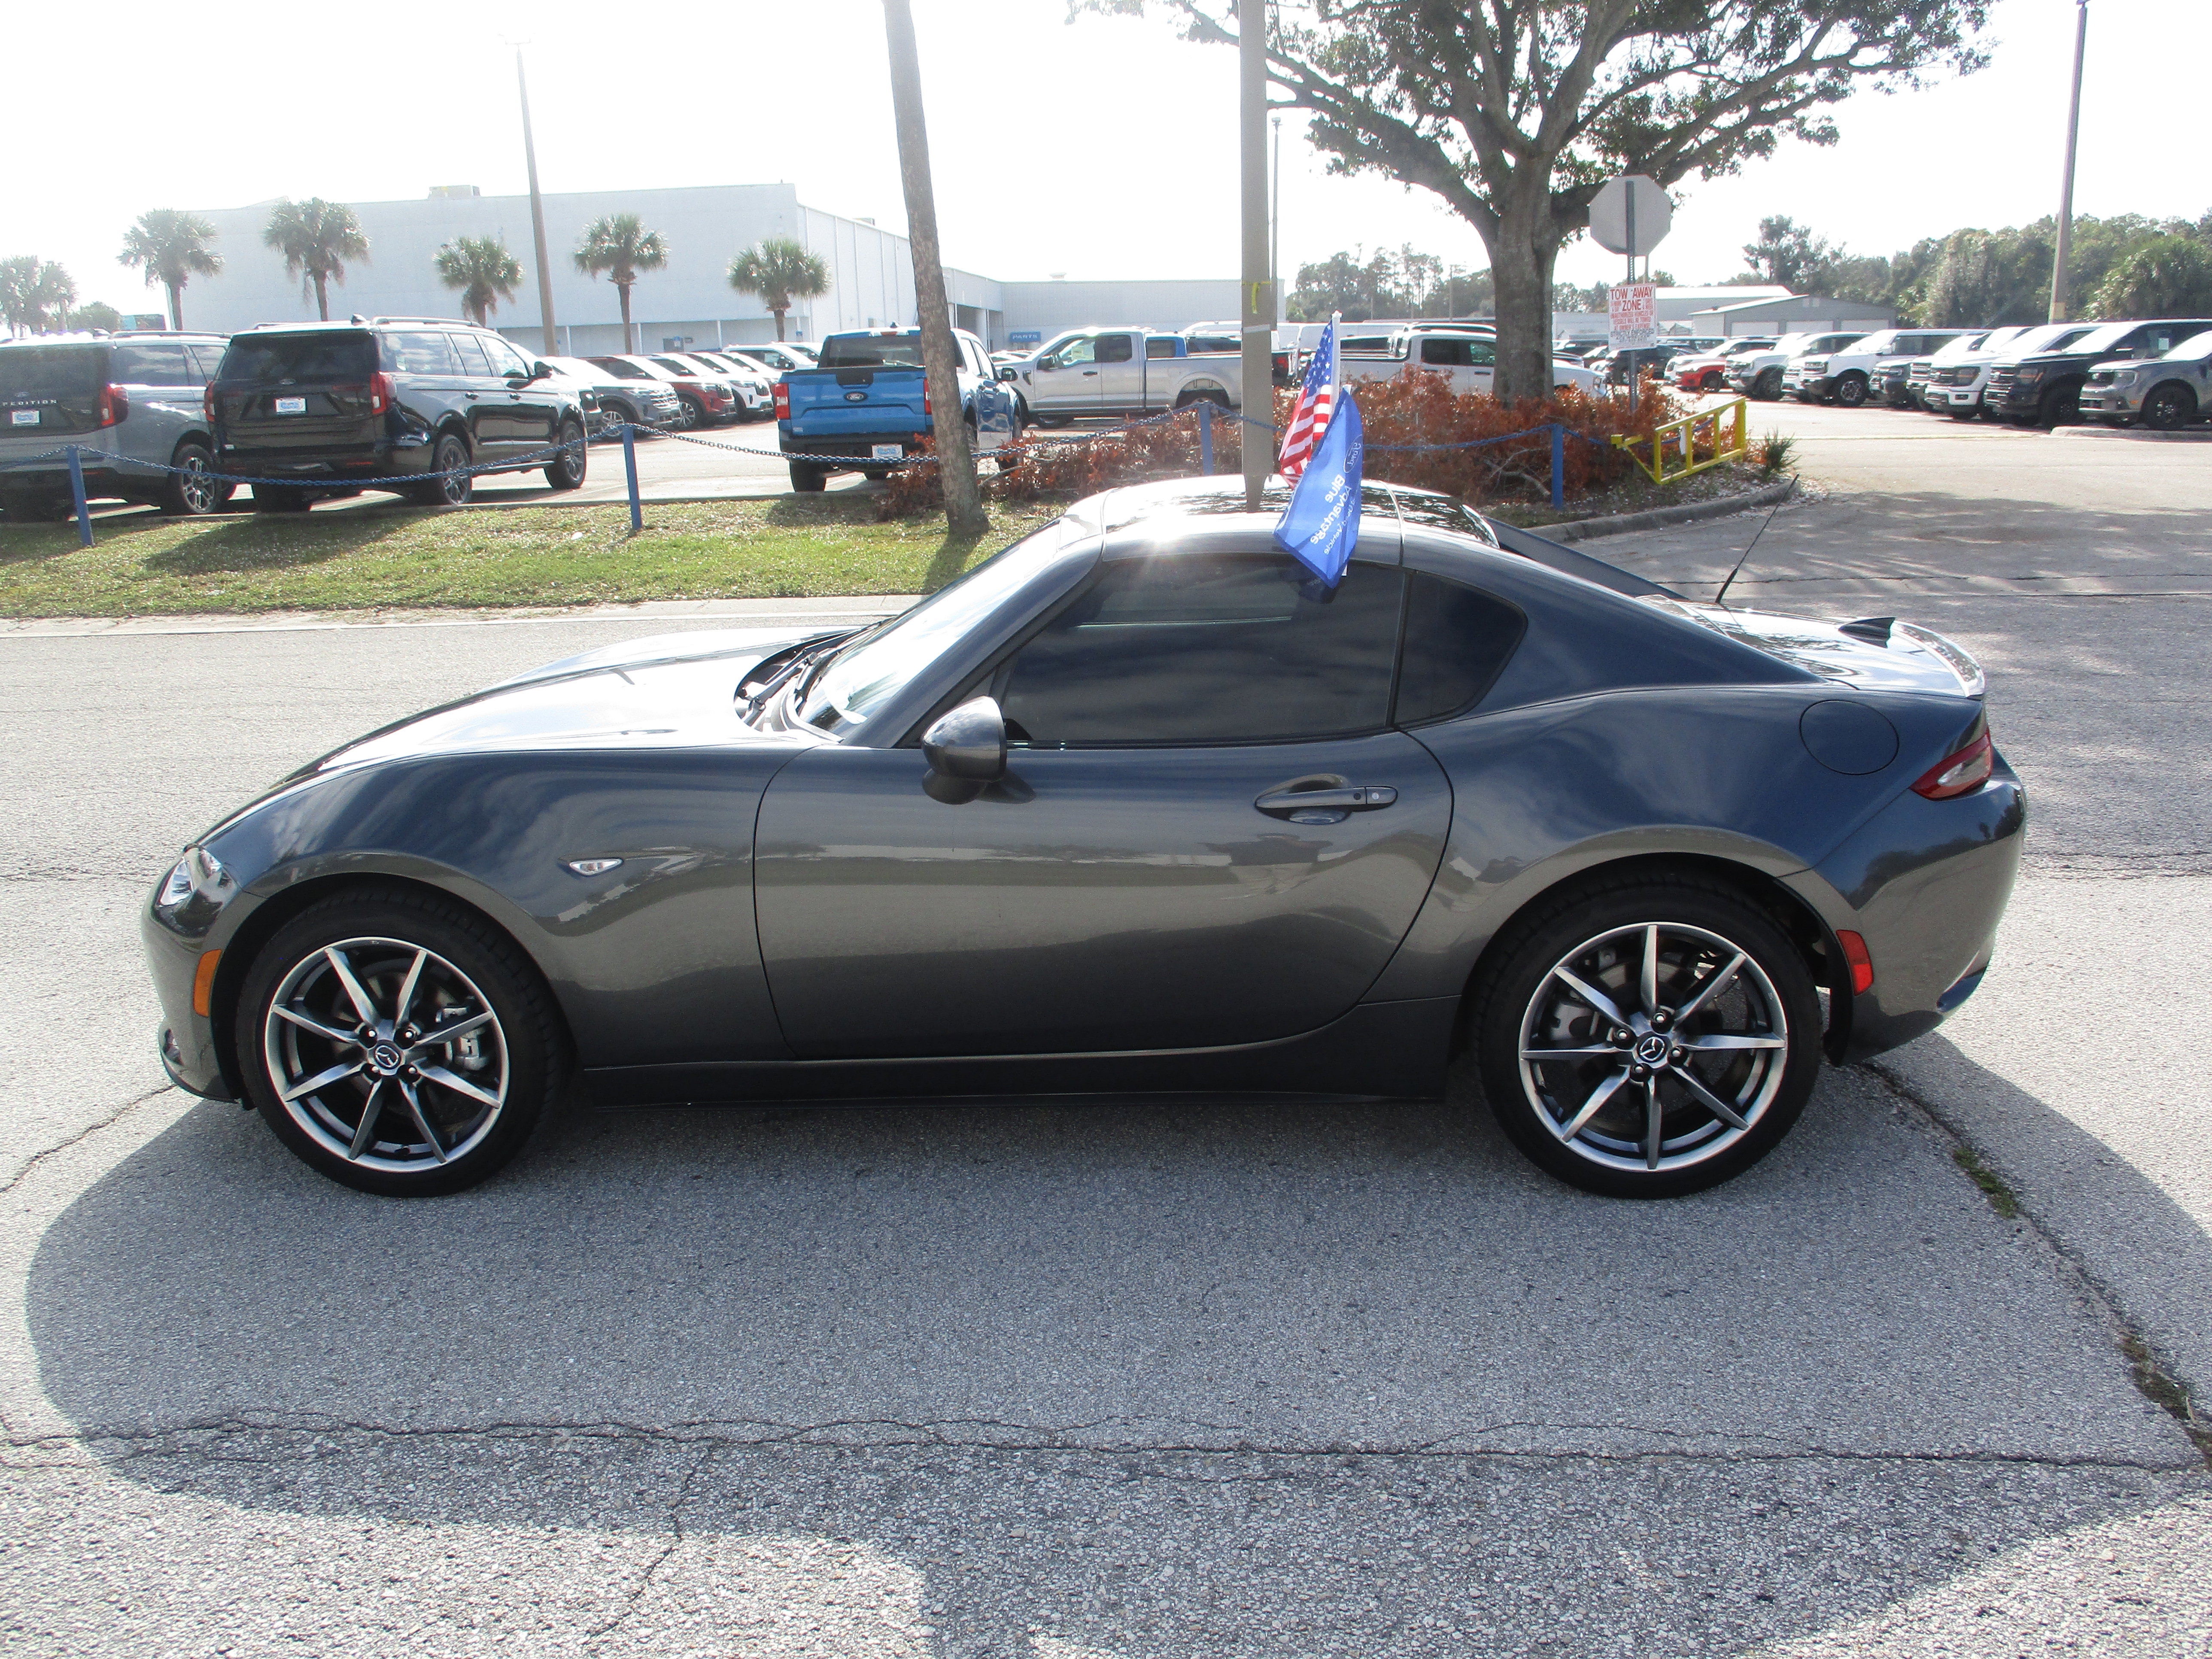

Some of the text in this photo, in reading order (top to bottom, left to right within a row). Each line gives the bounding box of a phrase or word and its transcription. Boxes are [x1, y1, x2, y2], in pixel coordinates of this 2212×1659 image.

[1610, 286, 1653, 300] TOW AWAY
[1622, 299, 1642, 311] ZONE
